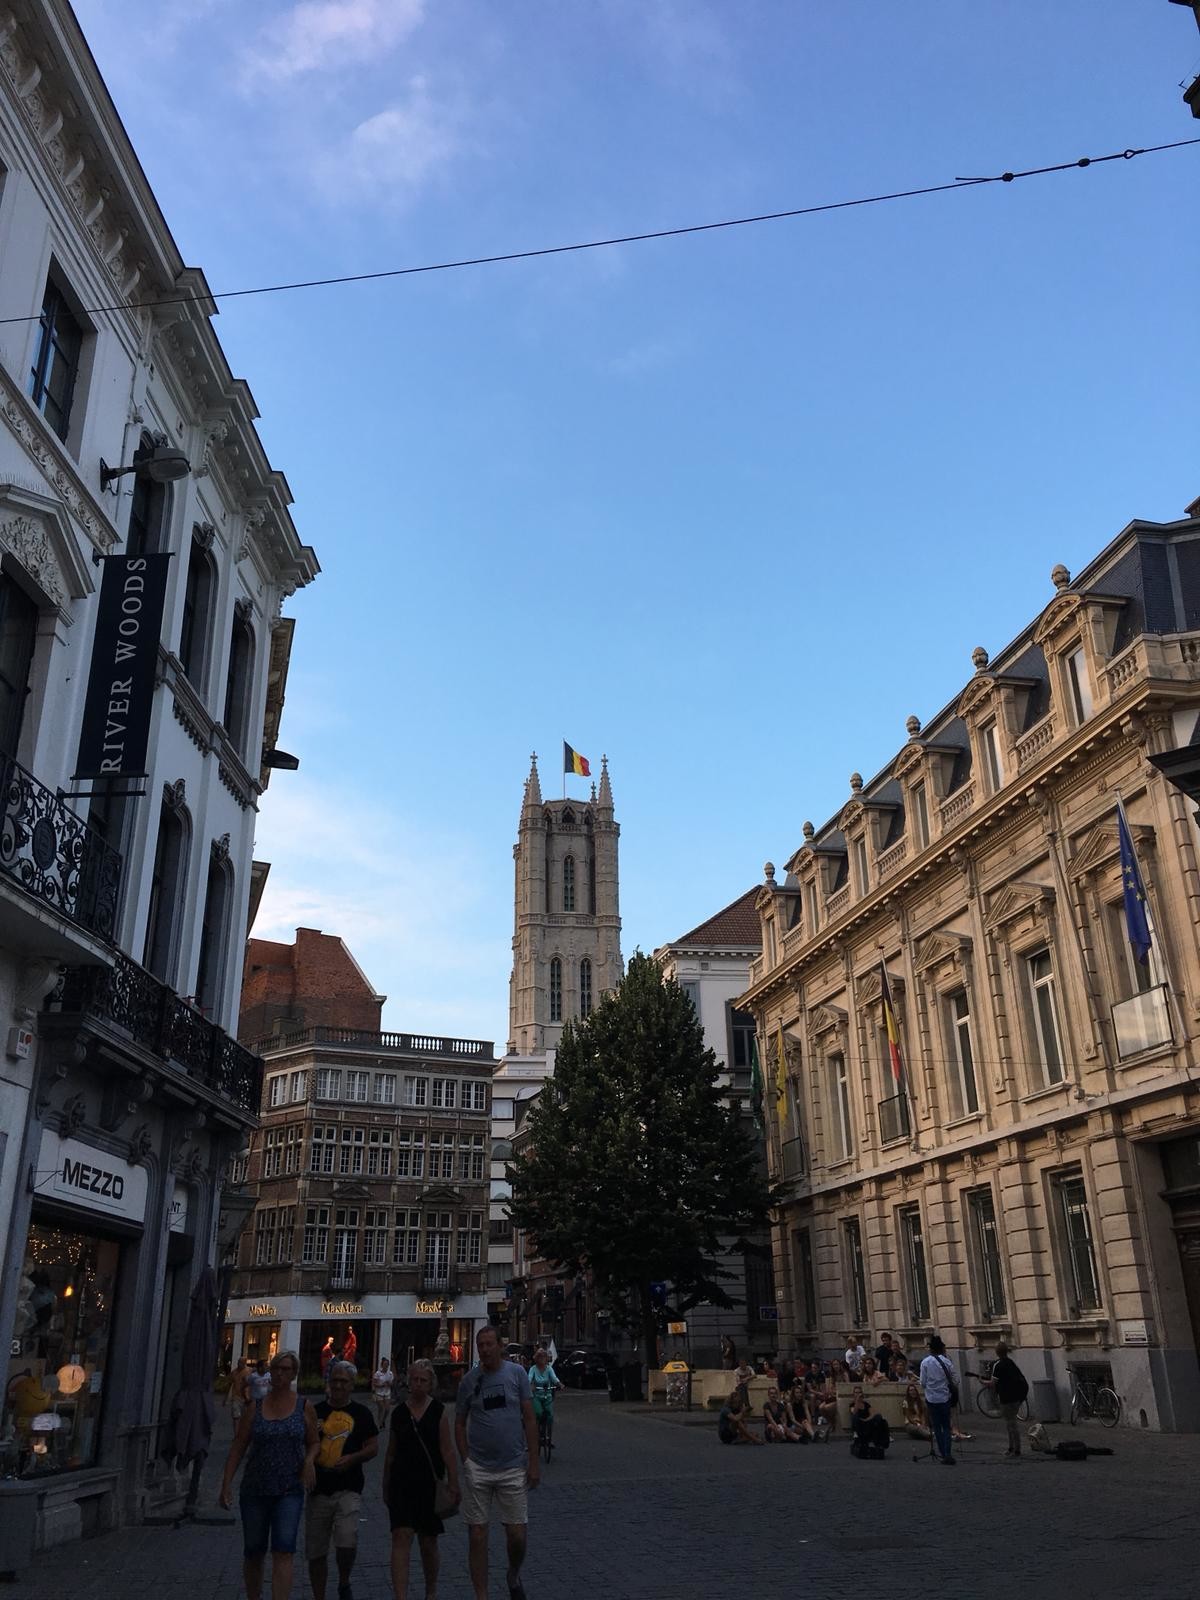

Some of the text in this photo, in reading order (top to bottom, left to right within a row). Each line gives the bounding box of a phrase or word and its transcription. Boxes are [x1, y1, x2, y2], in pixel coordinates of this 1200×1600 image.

[100, 558, 147, 774] RIVER WOODS
[62, 1158, 124, 1200] MEZZO
[321, 1301, 364, 1314] MaxMara
